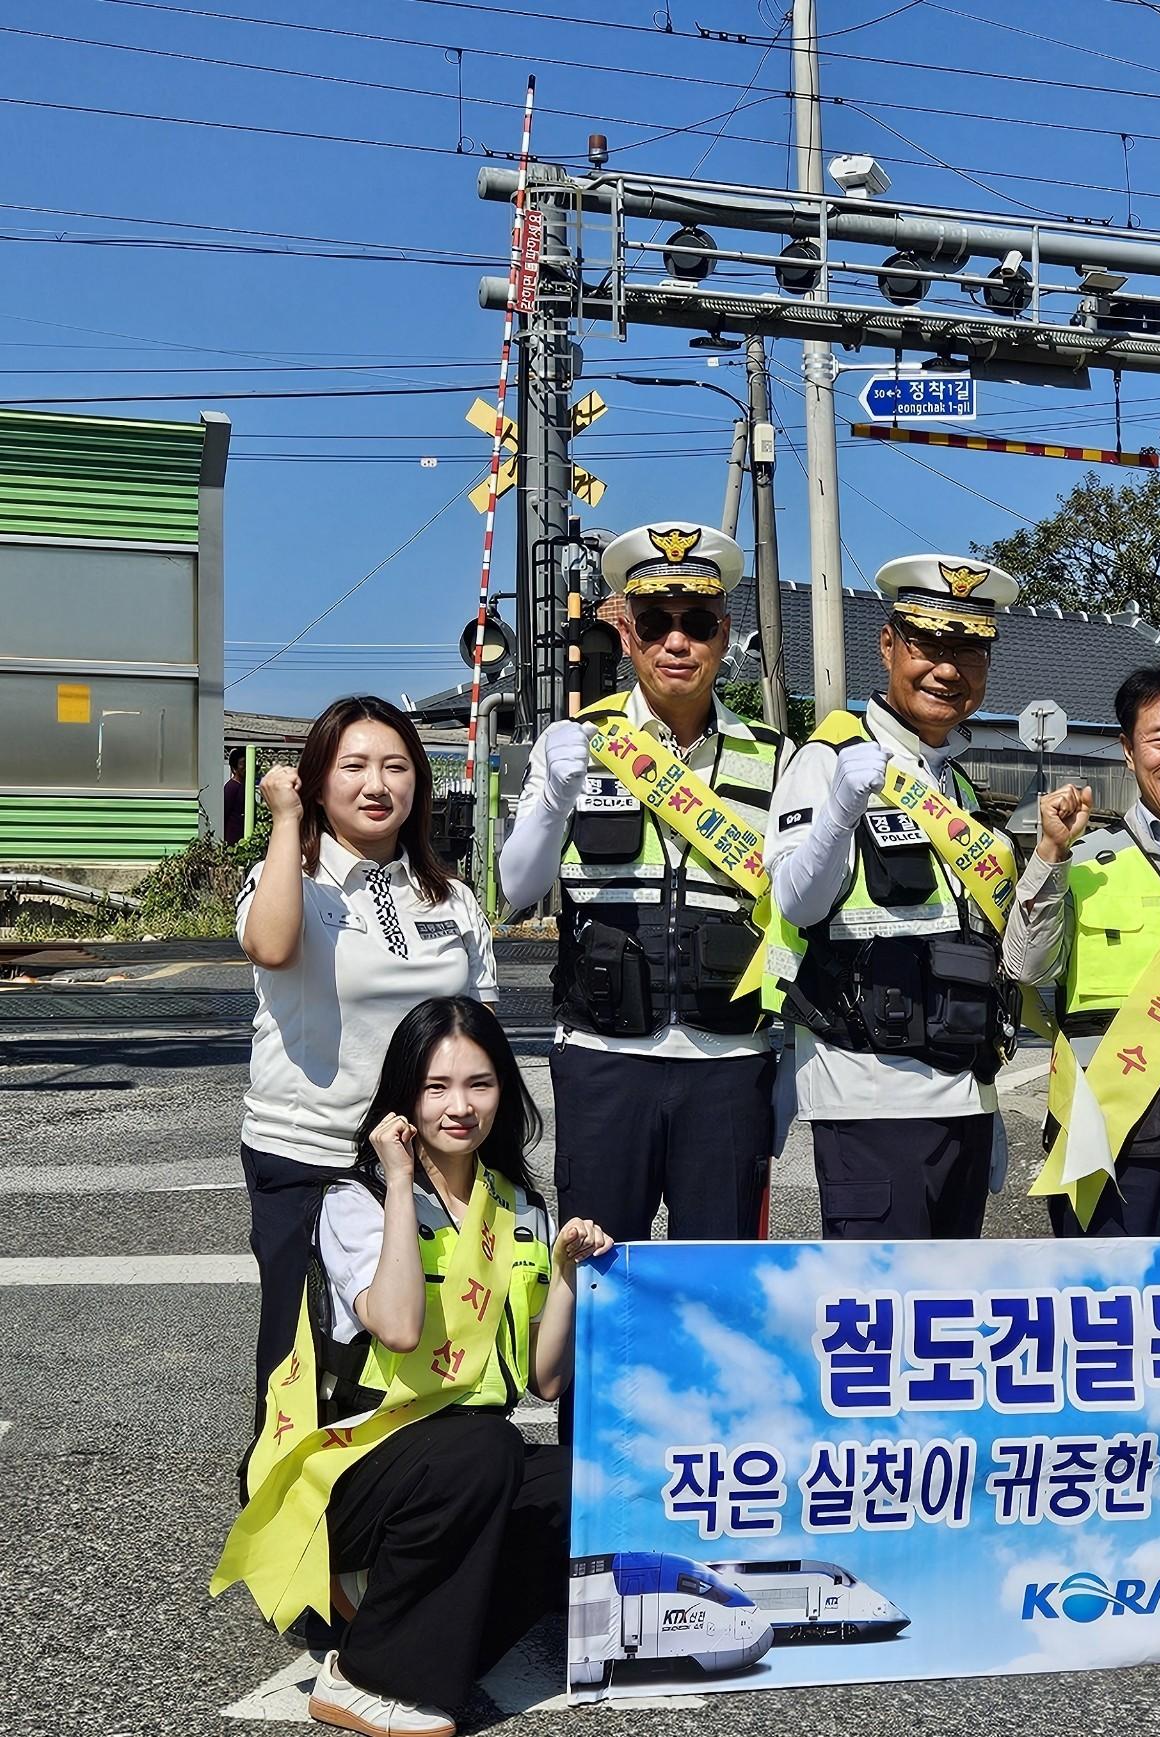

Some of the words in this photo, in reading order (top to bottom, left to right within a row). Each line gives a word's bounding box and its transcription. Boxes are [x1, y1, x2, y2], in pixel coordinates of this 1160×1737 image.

[909, 381, 969, 401] 정착1길
[647, 763, 685, 808] 안전모
[585, 798, 633, 807] POLICE
[668, 785, 703, 814] 착
[872, 814, 917, 832] 경찰
[881, 833, 923, 842] POLICE
[669, 1449, 780, 1532] 작은
[805, 1445, 970, 1527] 실천이
[993, 1439, 1153, 1518] 귀중한
